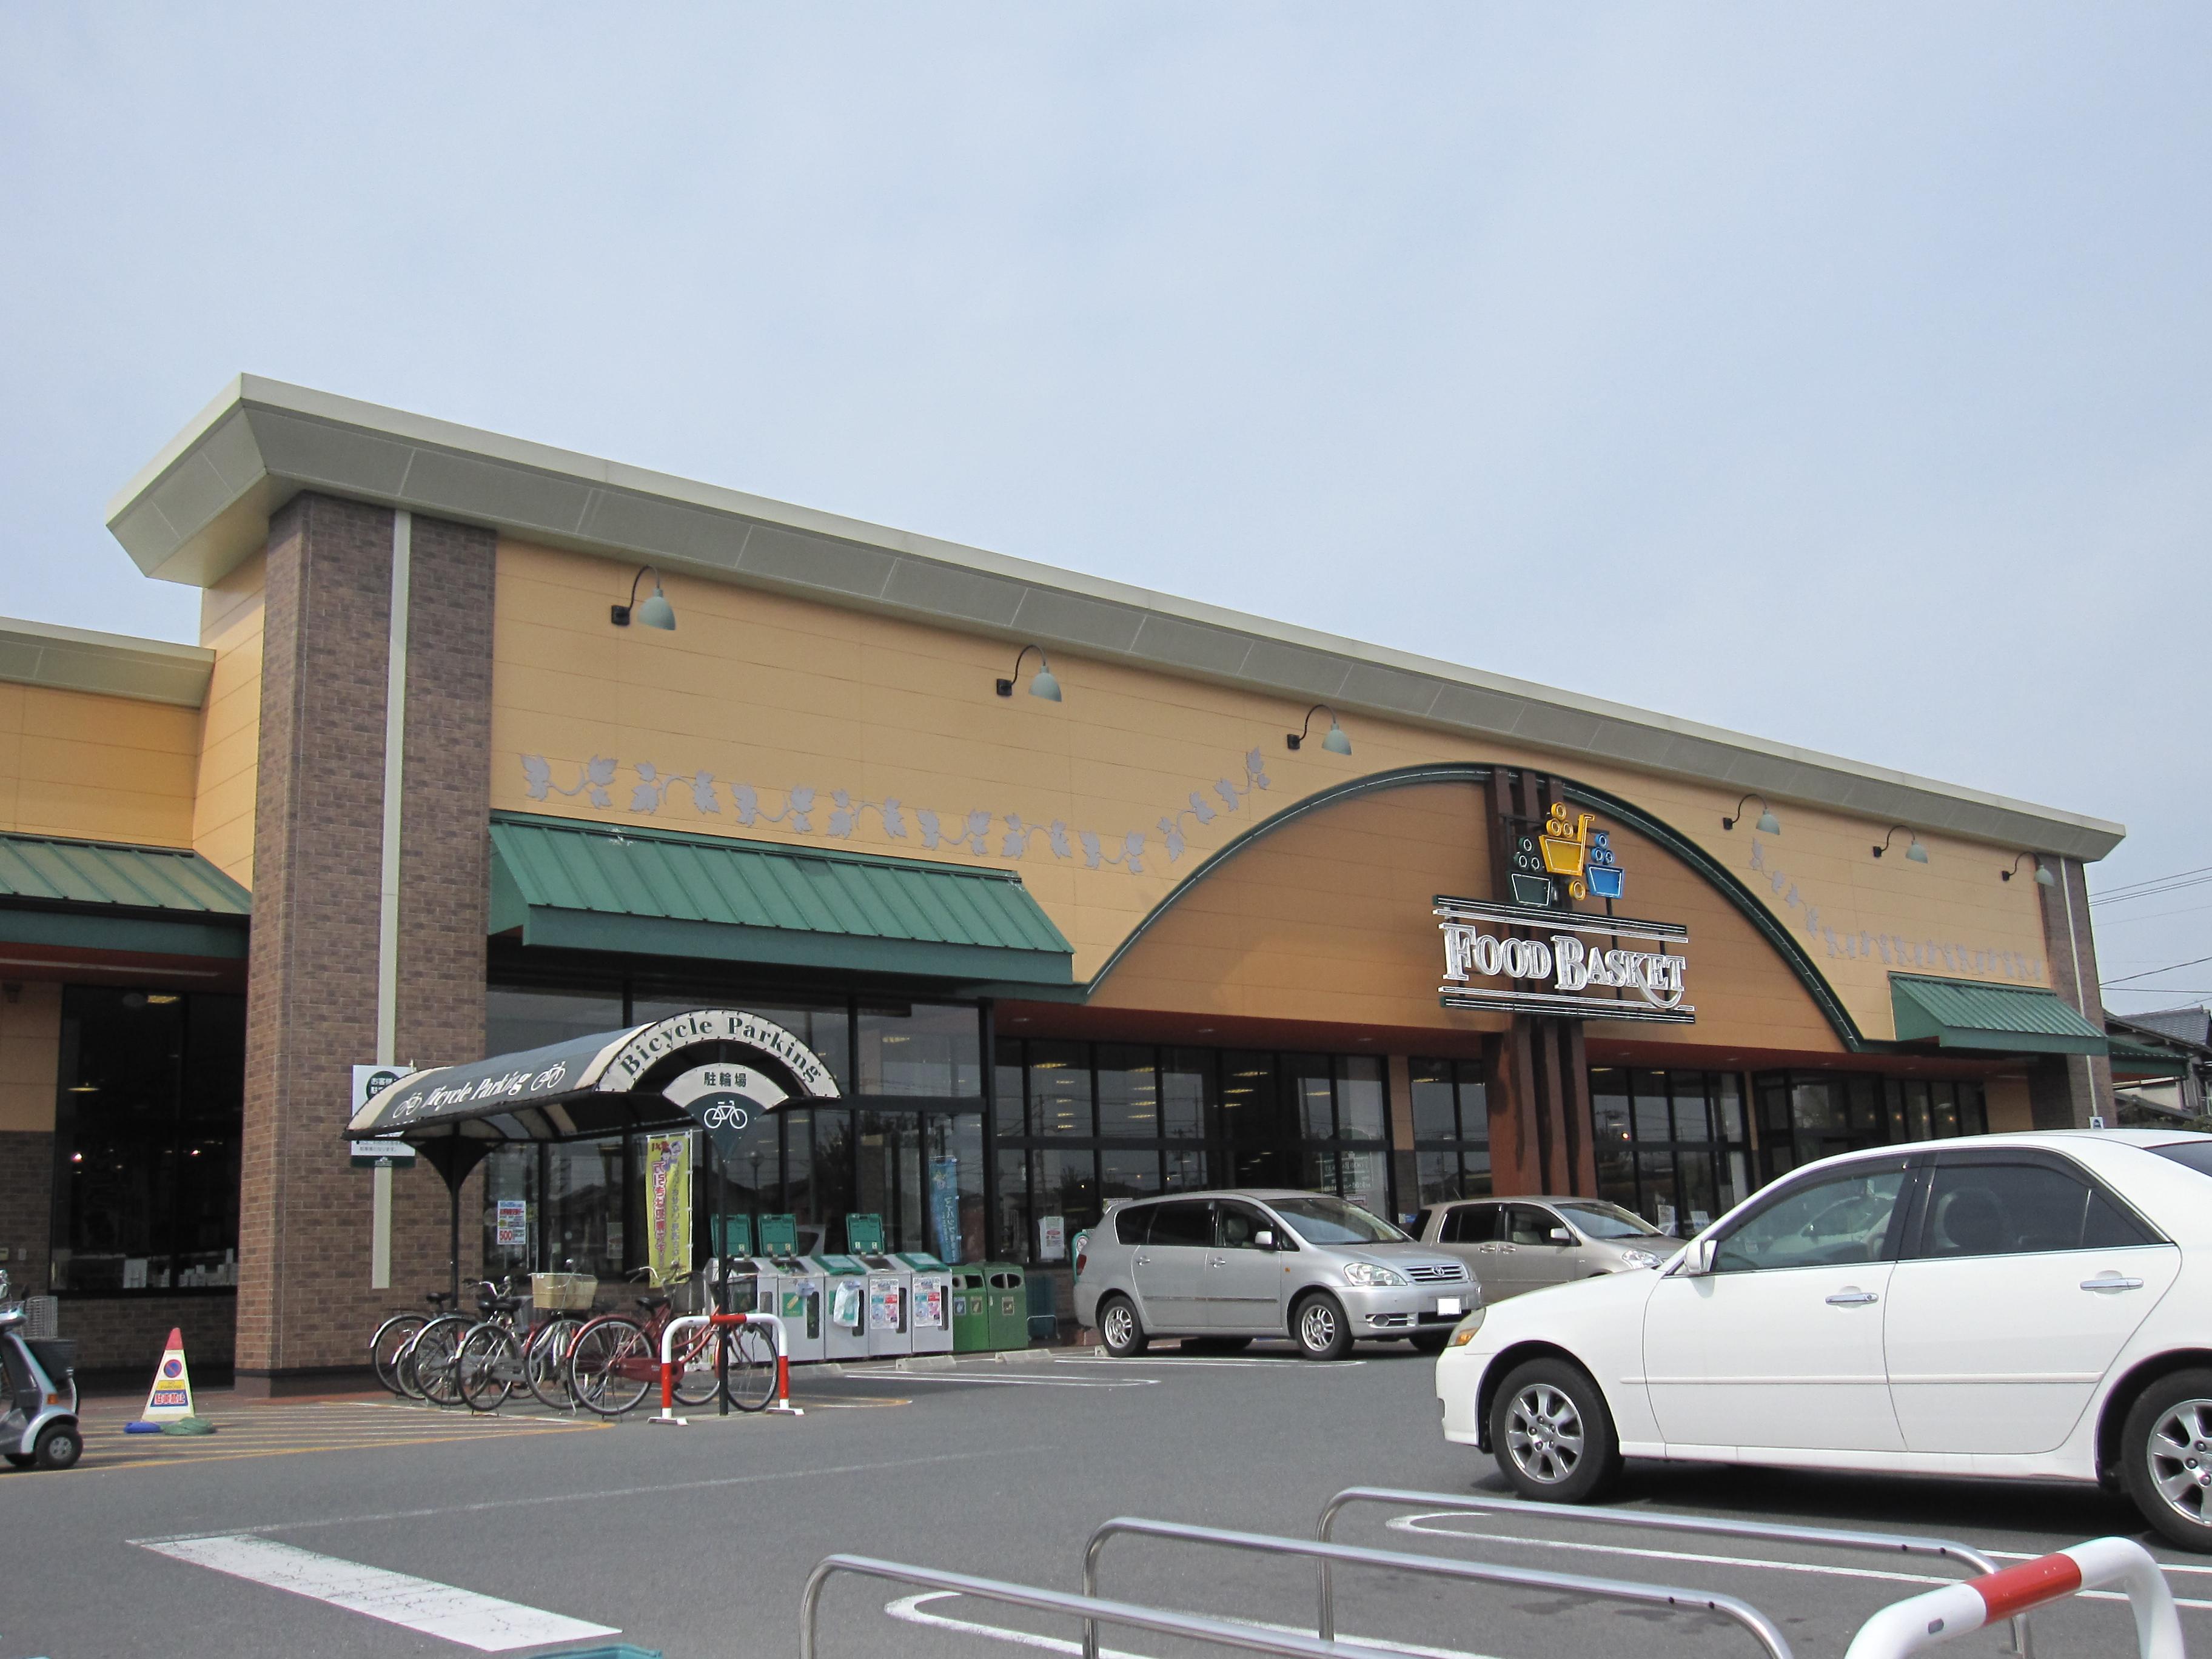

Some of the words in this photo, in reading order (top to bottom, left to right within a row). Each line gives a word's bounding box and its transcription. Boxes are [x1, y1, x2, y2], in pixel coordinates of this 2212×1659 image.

[1438, 922, 1552, 981] FOOD
[1550, 935, 1686, 1009] BASKET
[619, 1017, 713, 1077] Bicycle
[727, 1016, 821, 1083] Parking
[421, 1081, 472, 1111] Bicycle
[471, 1070, 533, 1101] Parking
[703, 1071, 747, 1087] 駐輪場
